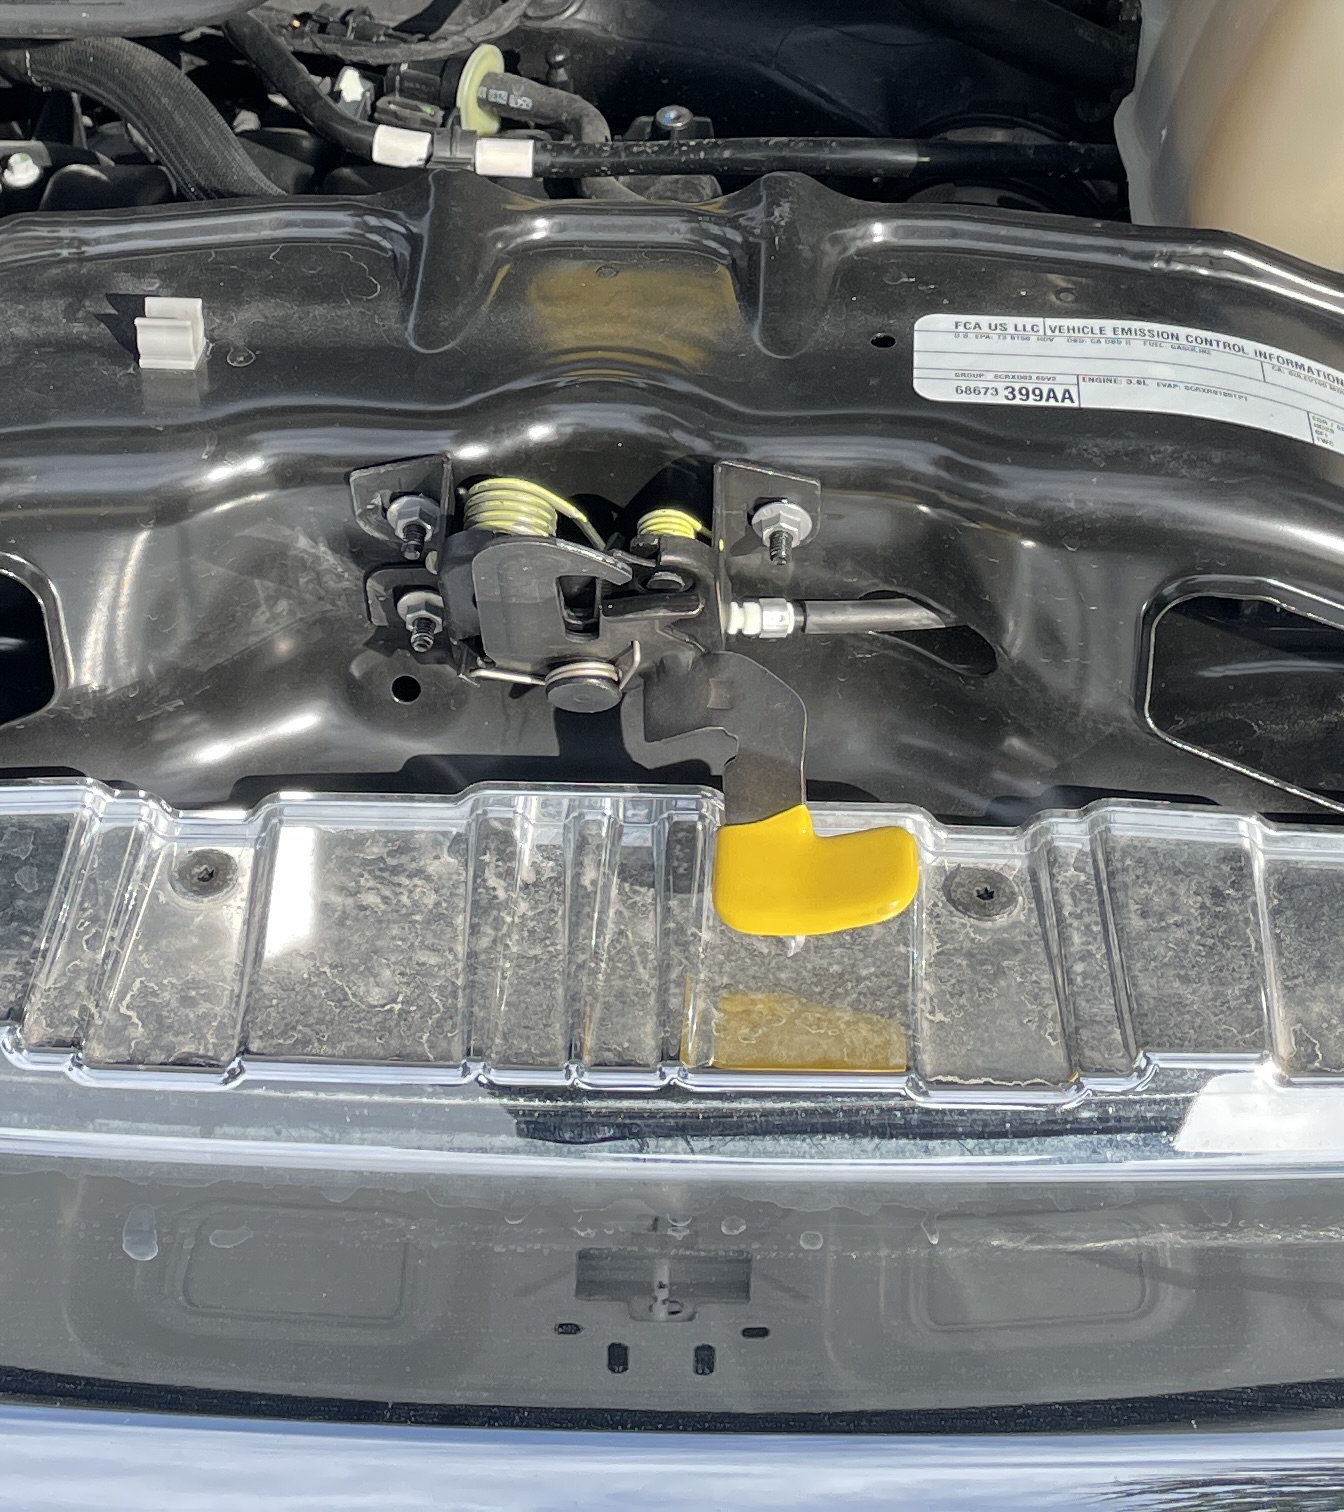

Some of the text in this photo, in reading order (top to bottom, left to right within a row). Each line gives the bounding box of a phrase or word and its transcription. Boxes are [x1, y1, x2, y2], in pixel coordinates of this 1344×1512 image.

[954, 320, 982, 331] FCA
[988, 322, 1008, 332] US
[1014, 322, 1040, 333] LLC
[1049, 324, 1107, 336] VEHICLE
[1113, 326, 1180, 342] EMISSION
[1185, 334, 1249, 355] CONTROL
[955, 385, 1076, 404] 68673 399AA
